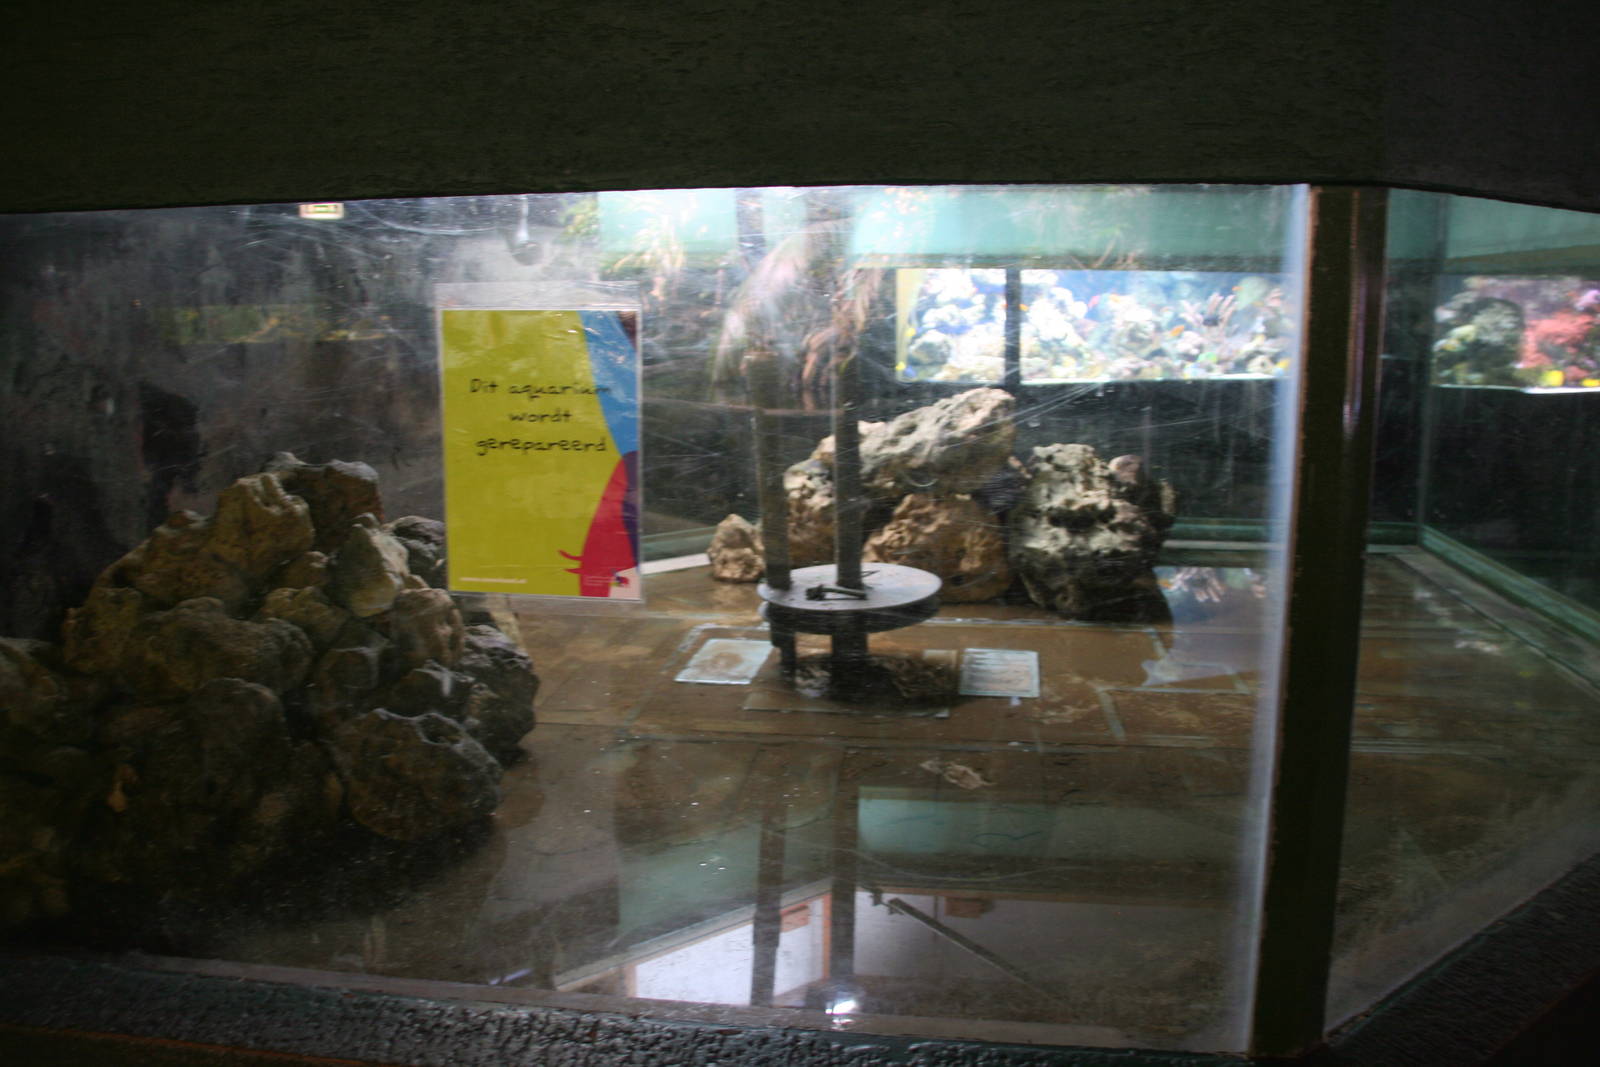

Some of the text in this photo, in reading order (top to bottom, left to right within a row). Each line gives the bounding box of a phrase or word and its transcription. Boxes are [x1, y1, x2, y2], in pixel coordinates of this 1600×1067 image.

[470, 378, 611, 399] Dit aquarium
[509, 408, 572, 422] wordt
[475, 437, 607, 456] gerepareerd
